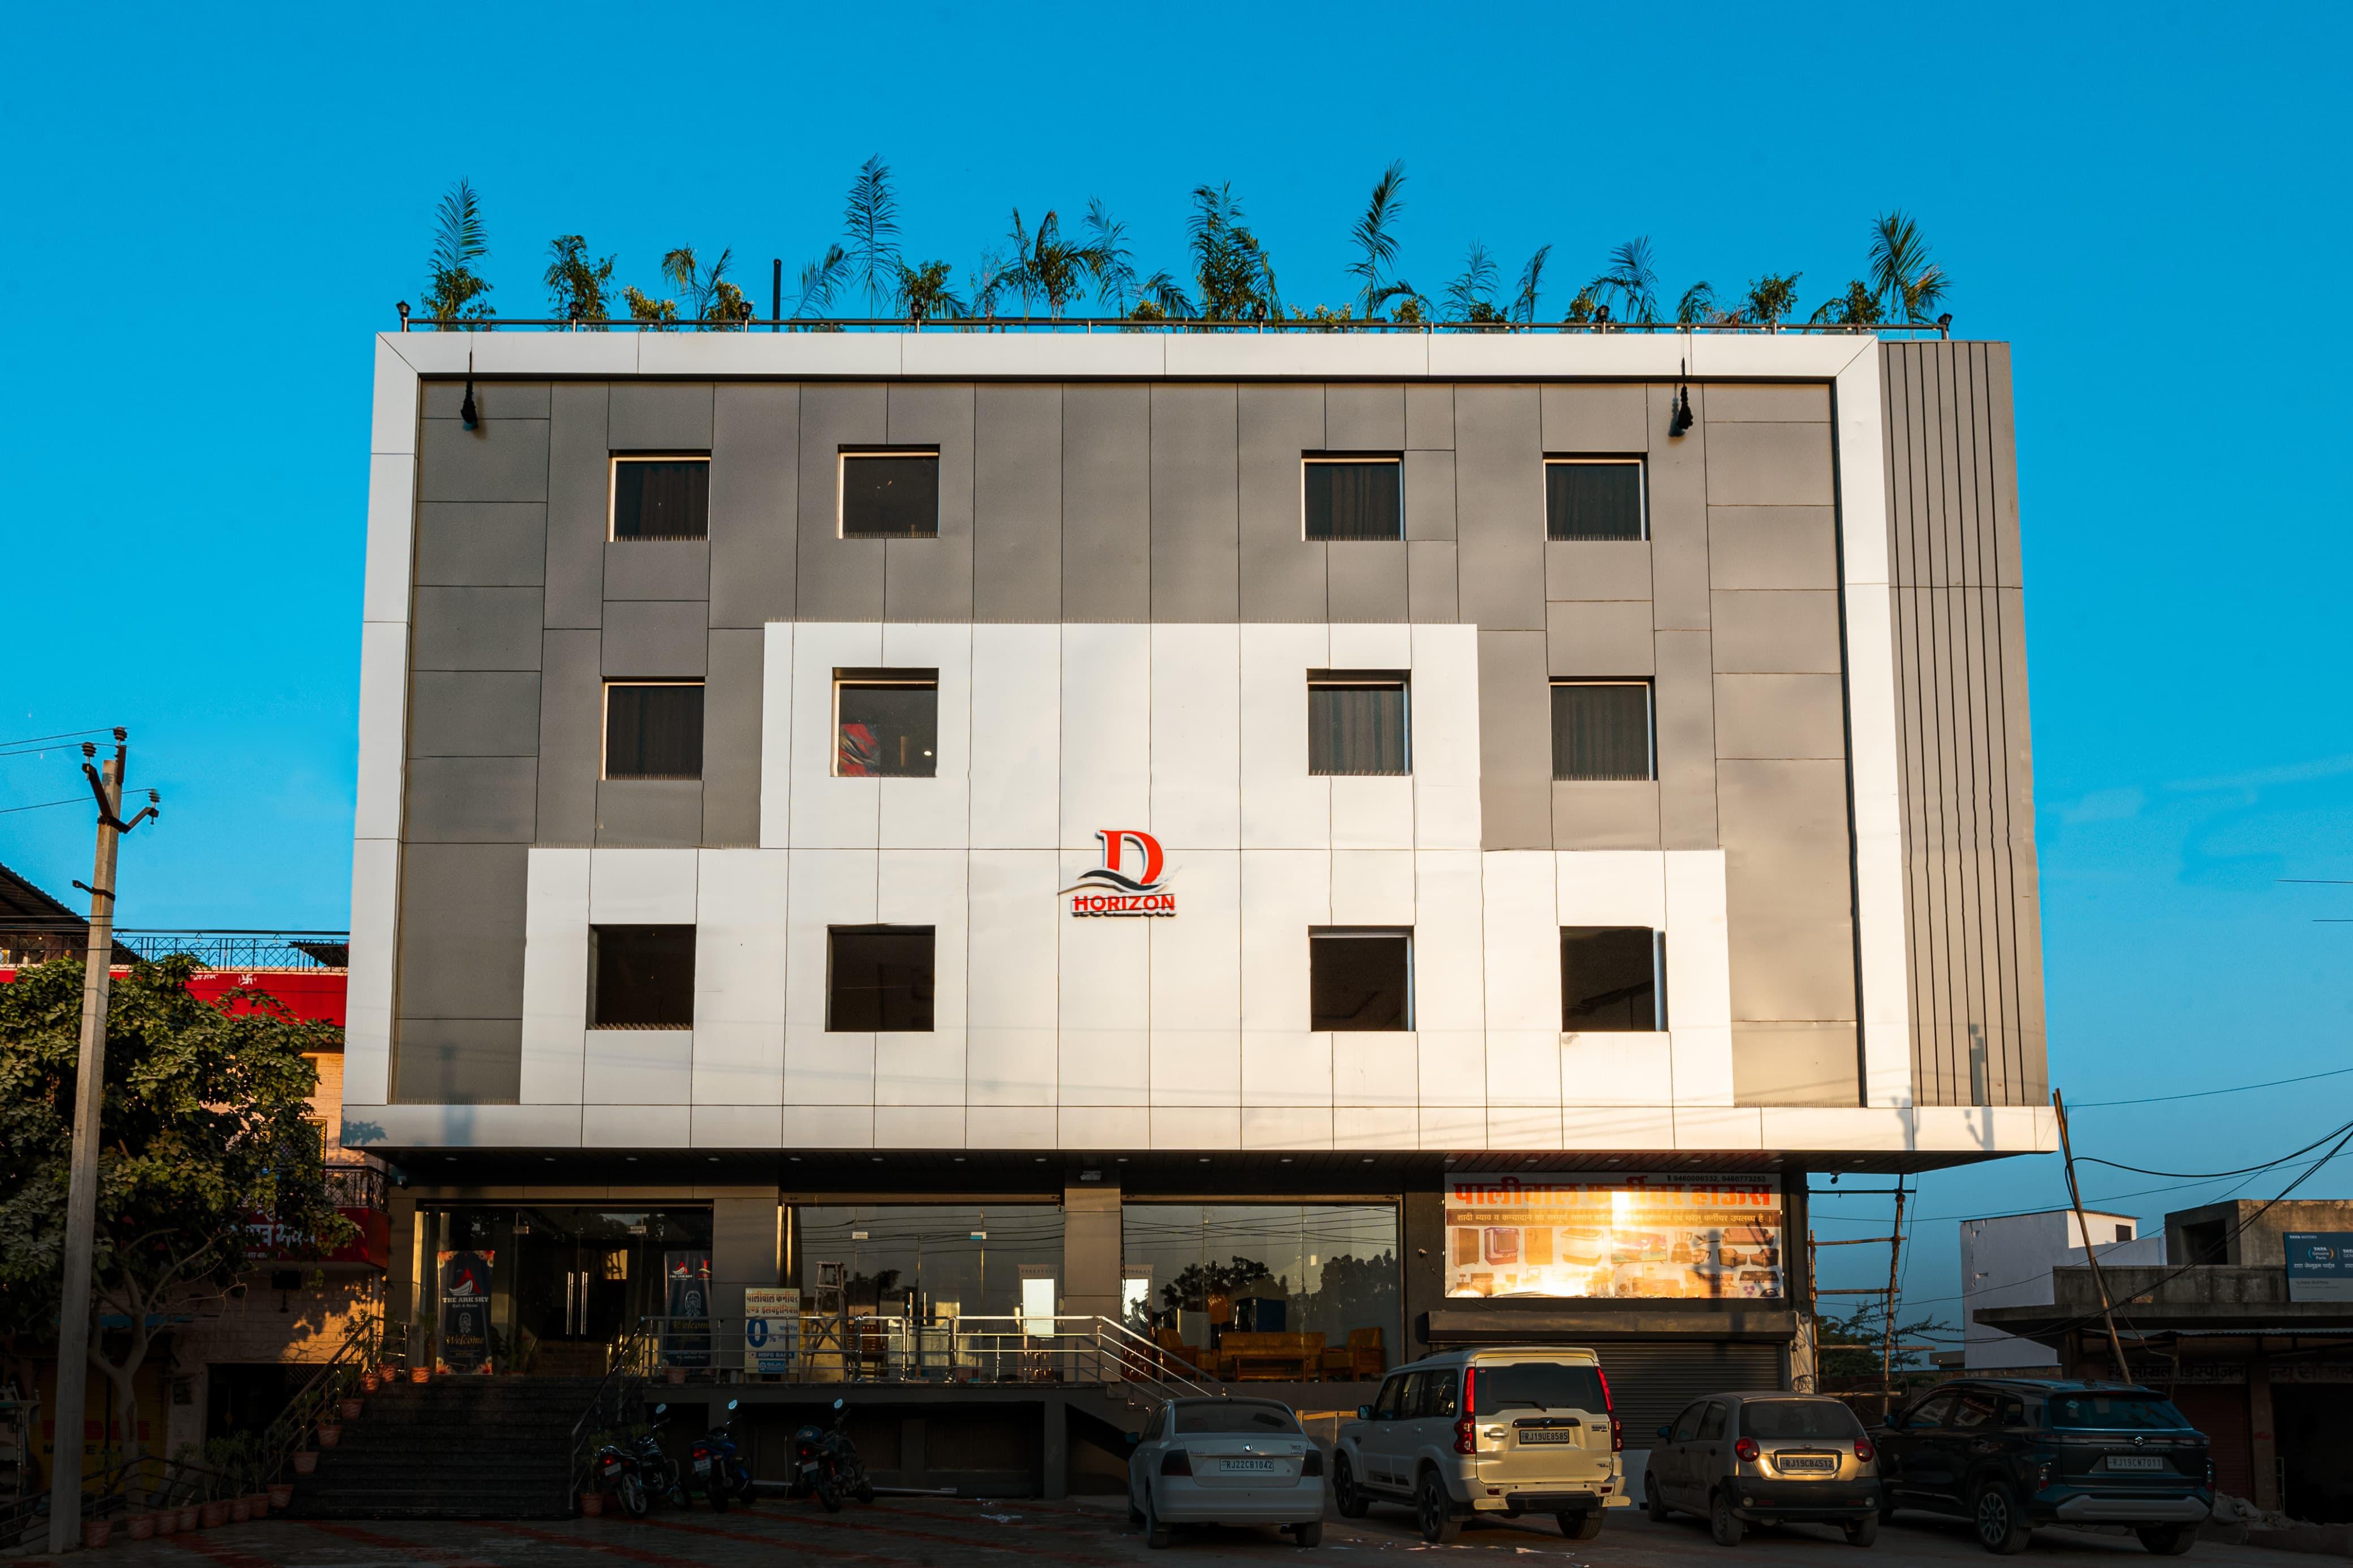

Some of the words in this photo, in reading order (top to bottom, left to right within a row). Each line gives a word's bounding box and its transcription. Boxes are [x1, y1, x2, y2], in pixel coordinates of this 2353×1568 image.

[1074, 895, 1175, 912] HORIZON
[1453, 1176, 1581, 1205] पालीवाल
[1457, 1212, 1473, 1221] शादी
[747, 1291, 775, 1303] पालीवाल
[446, 1334, 484, 1345] Welcome
[1525, 1432, 1568, 1441] RJ19UE8585
[1226, 1461, 1273, 1469] RJ22CB1042
